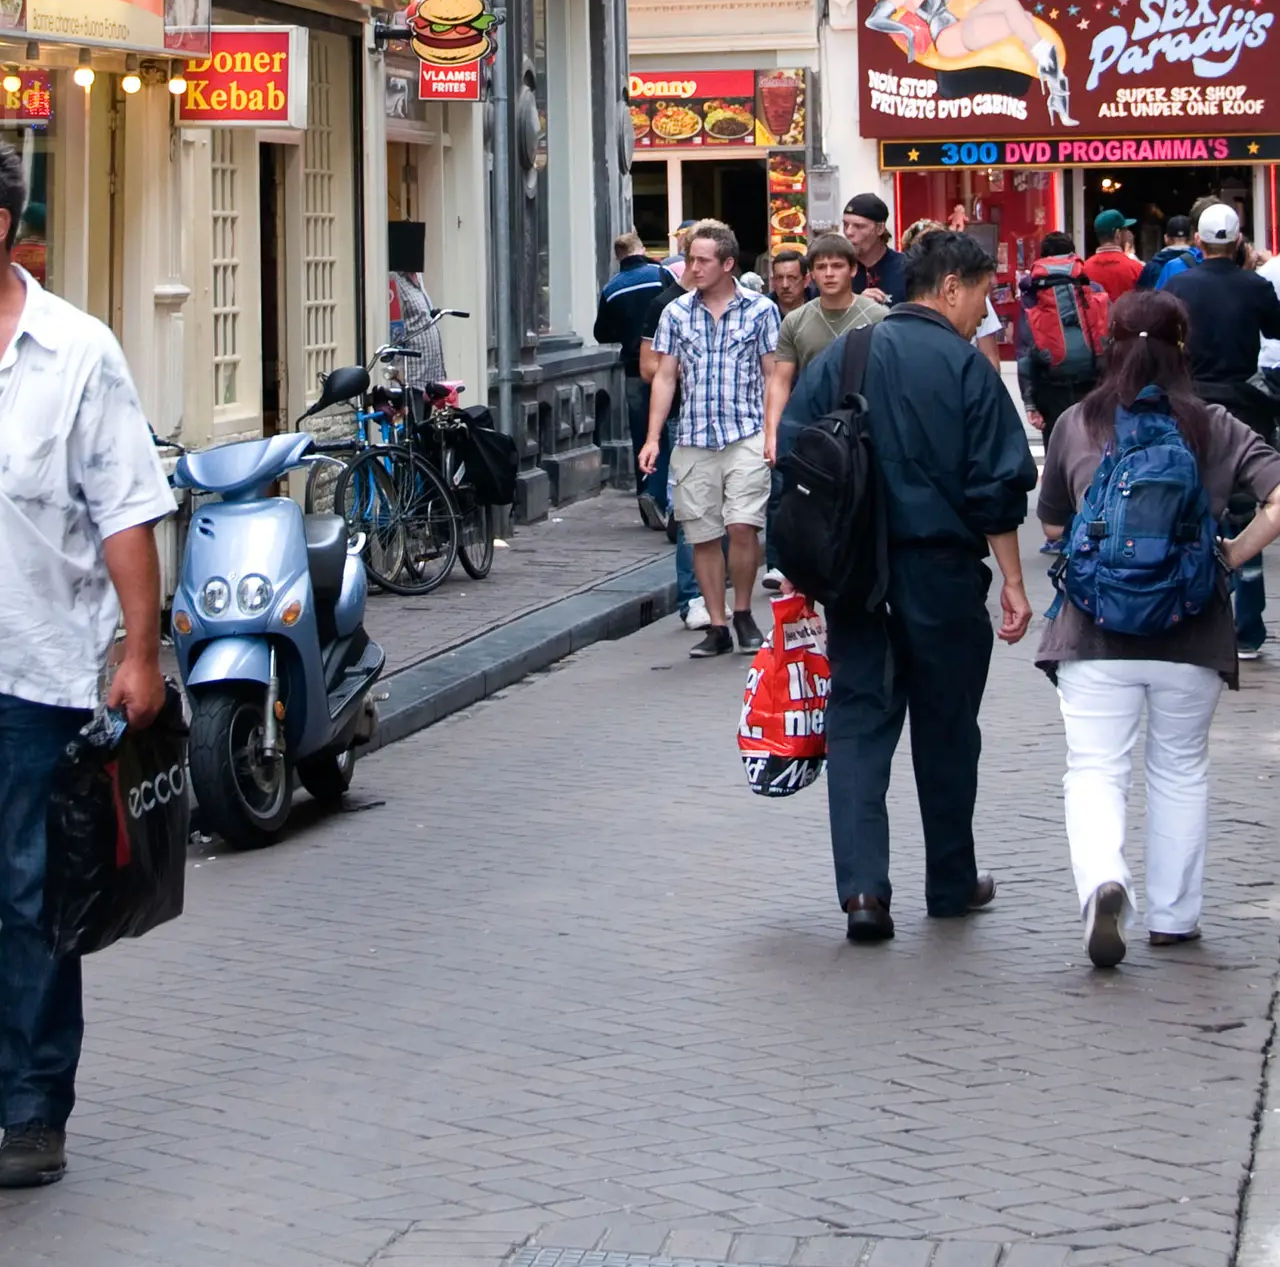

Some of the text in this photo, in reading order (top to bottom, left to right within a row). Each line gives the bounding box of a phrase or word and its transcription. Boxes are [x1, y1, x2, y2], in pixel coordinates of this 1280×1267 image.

[422, 71, 477, 82] VLAAMSE
[628, 76, 697, 98] Donny
[867, 69, 938, 98] NON STOP
[185, 80, 286, 112] Kebab
[432, 83, 466, 93] FRITES
[1116, 85, 1248, 103] SUPER SEX SHOP
[937, 97, 972, 119] DVD
[1098, 99, 1266, 118] ALL UNDER ONE ROOF
[941, 138, 1229, 165] 300 DVD PROGRAMMA'S
[128, 763, 184, 819] ecco
